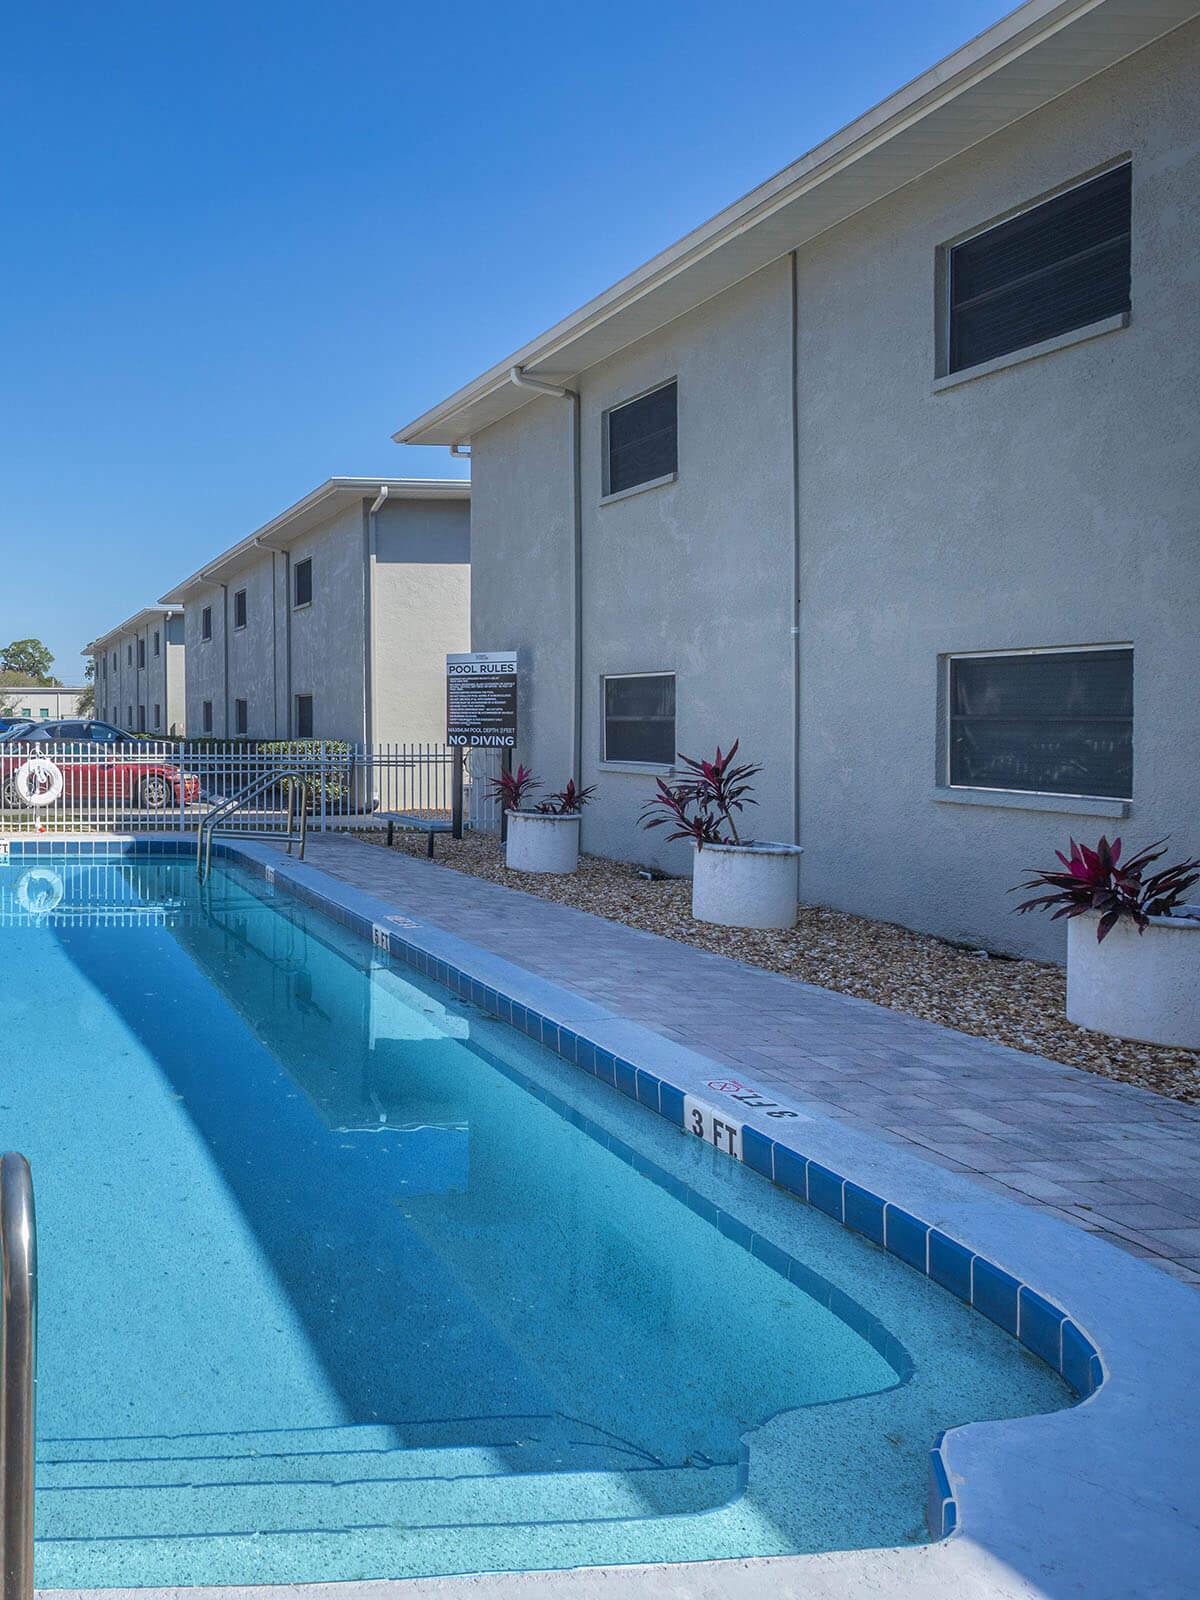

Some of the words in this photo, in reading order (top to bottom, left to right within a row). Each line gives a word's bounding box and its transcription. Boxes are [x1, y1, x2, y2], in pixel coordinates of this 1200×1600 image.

[449, 665, 477, 674] POOL
[480, 664, 514, 673] RULES
[449, 735, 467, 745] NO
[471, 735, 514, 746] DIVING
[730, 1093, 778, 1107] FT
[766, 1110, 799, 1118] 3
[692, 1108, 704, 1138] 3
[713, 1118, 738, 1158] FT.
